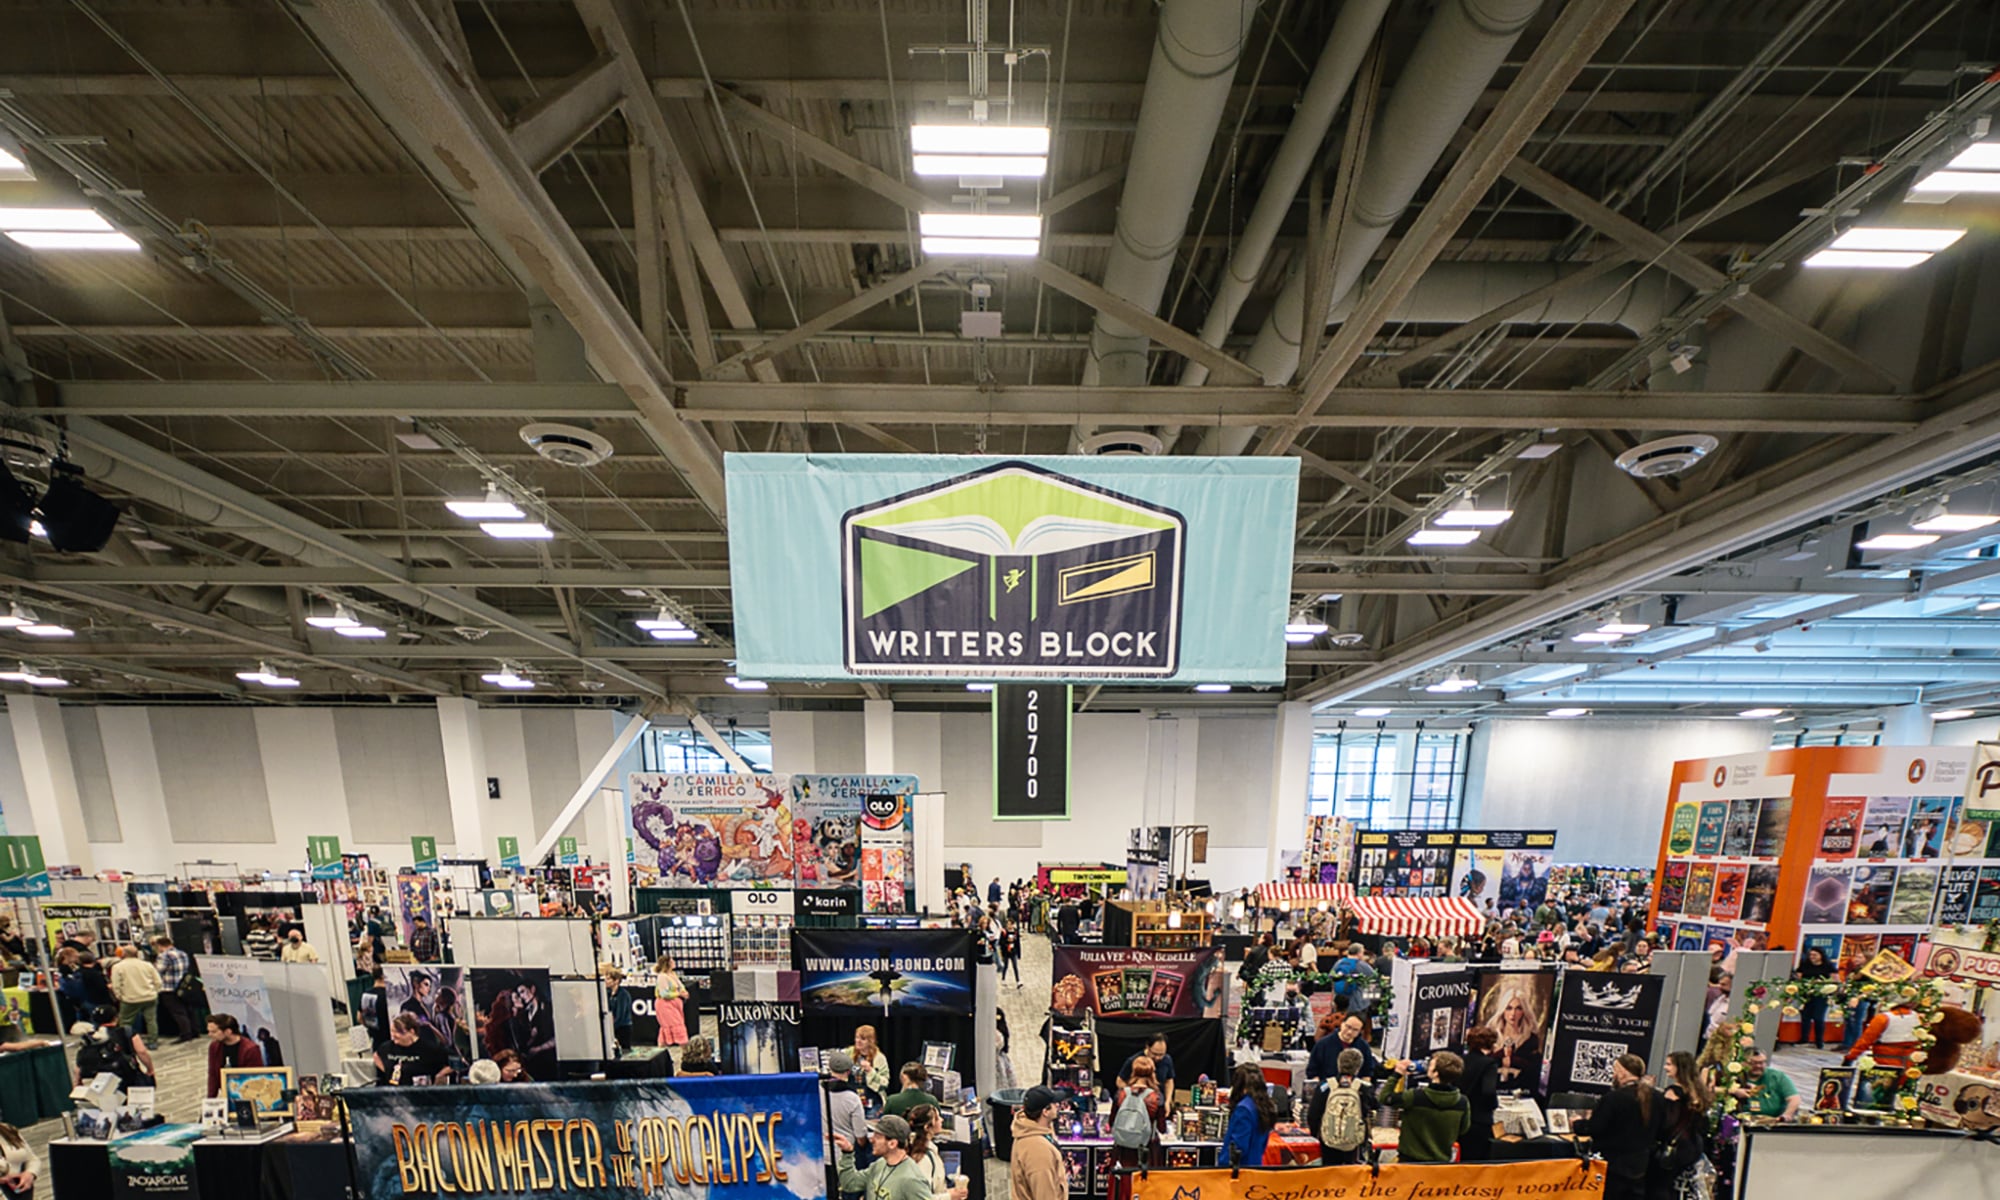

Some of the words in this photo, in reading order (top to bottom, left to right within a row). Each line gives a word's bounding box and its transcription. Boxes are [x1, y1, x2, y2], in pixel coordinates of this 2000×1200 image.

[868, 630, 1024, 657] WRITERS
[1040, 630, 1157, 657] BLOCK
[1027, 690, 1038, 798] 20700
[686, 776, 745, 785] CAMILLA
[831, 778, 889, 787] CAMILLA
[686, 786, 746, 796] d'ERRICO
[869, 801, 894, 811] OLO
[421, 841, 430, 856] G
[747, 893, 777, 904] OLO
[815, 896, 847, 907] karin
[47, 907, 71, 918] Doug
[805, 958, 965, 972] WWW.JASON-BOND.COM
[1080, 951, 1105, 962] JULIA
[1106, 951, 1125, 962] VEE
[1131, 951, 1152, 963] KEN
[1964, 956, 2000, 974] PUG
[1419, 982, 1470, 1000] CROWNS
[632, 999, 657, 1016] OL
[720, 1004, 800, 1027] JANKOWSKI
[1562, 1013, 1598, 1023] NICOLA
[614, 1120, 633, 1153] OF
[392, 1118, 497, 1193] BACON
[491, 1118, 608, 1192] MASTER
[637, 1109, 788, 1195] APOCALYPSE
[610, 1153, 637, 1189] THE
[1245, 1184, 1346, 1200] Explore
[1359, 1181, 1398, 1198] the
[1408, 1182, 1505, 1200] fantasy
[1516, 1175, 1601, 1195] worlds
